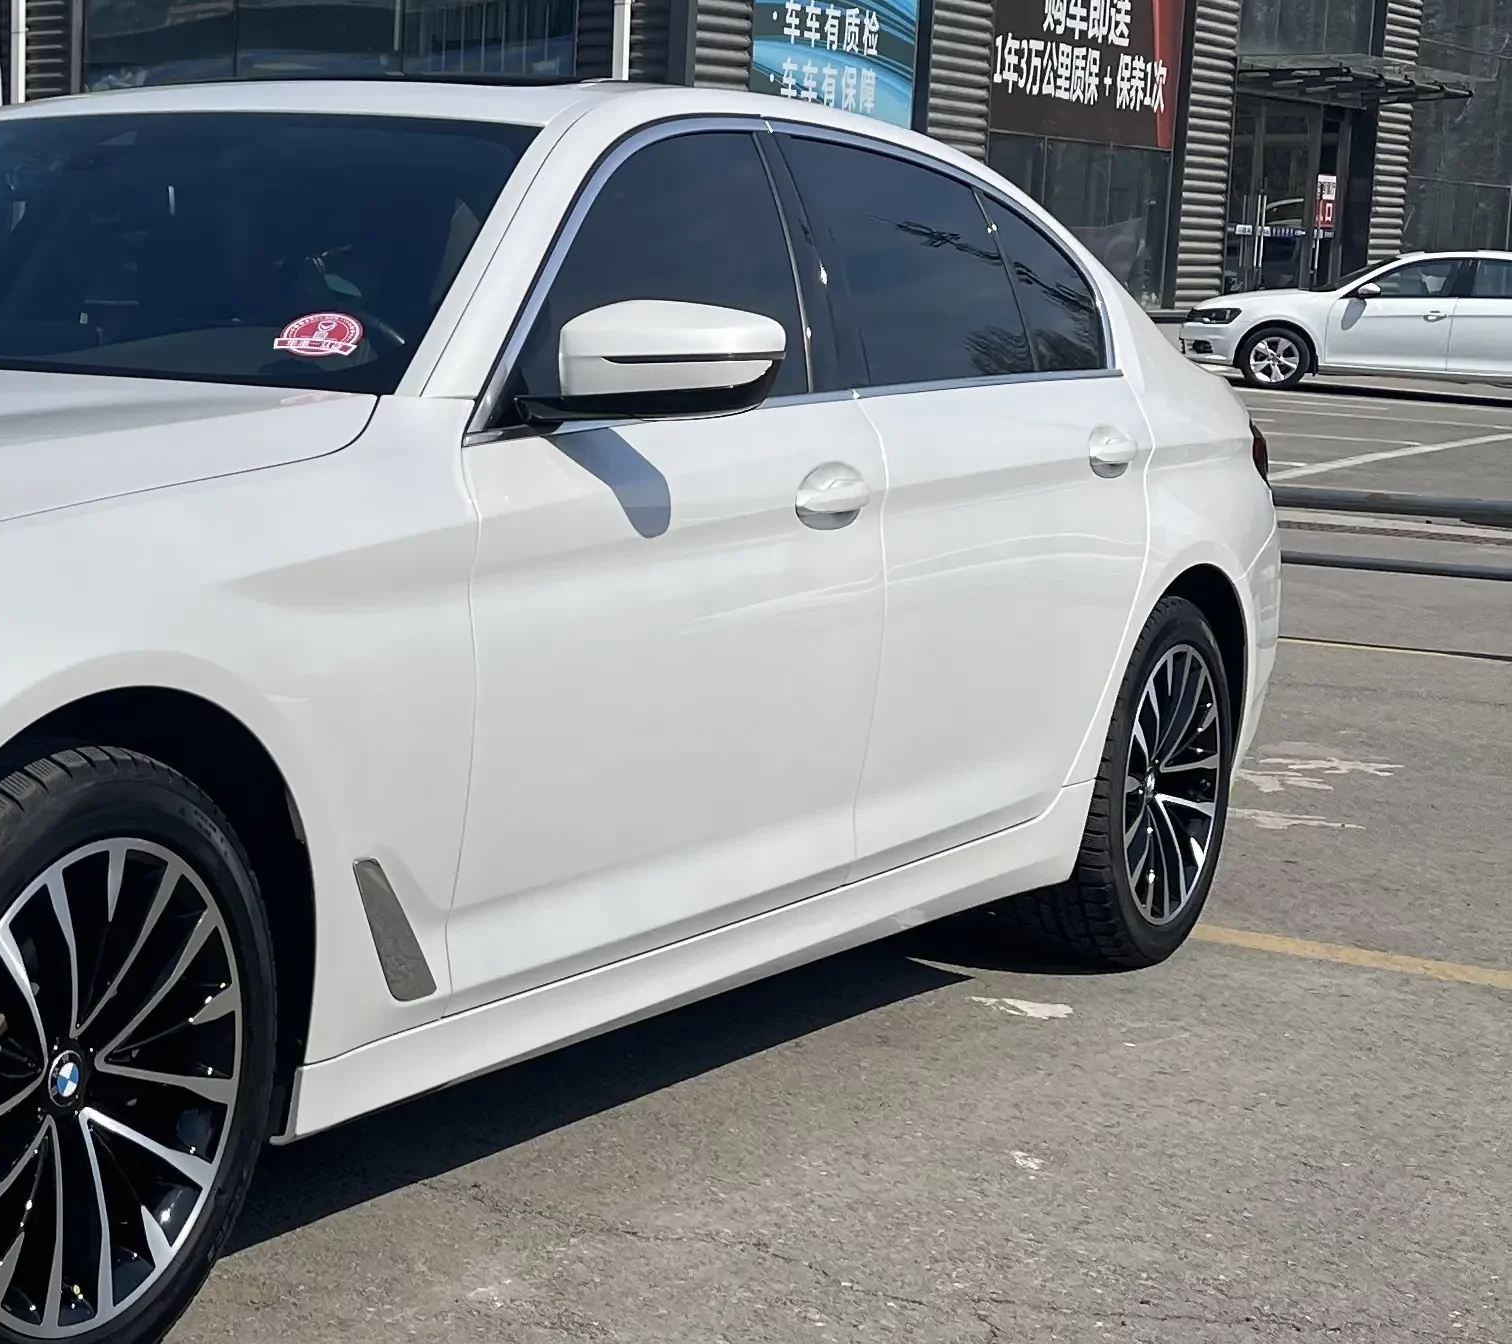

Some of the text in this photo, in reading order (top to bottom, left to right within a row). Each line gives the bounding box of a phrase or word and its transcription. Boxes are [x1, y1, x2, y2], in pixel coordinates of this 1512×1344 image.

[780, 56, 877, 113] 车车有保障
[993, 32, 1100, 105] 1年3万公里质保
[1116, 52, 1168, 113] 保养1次
